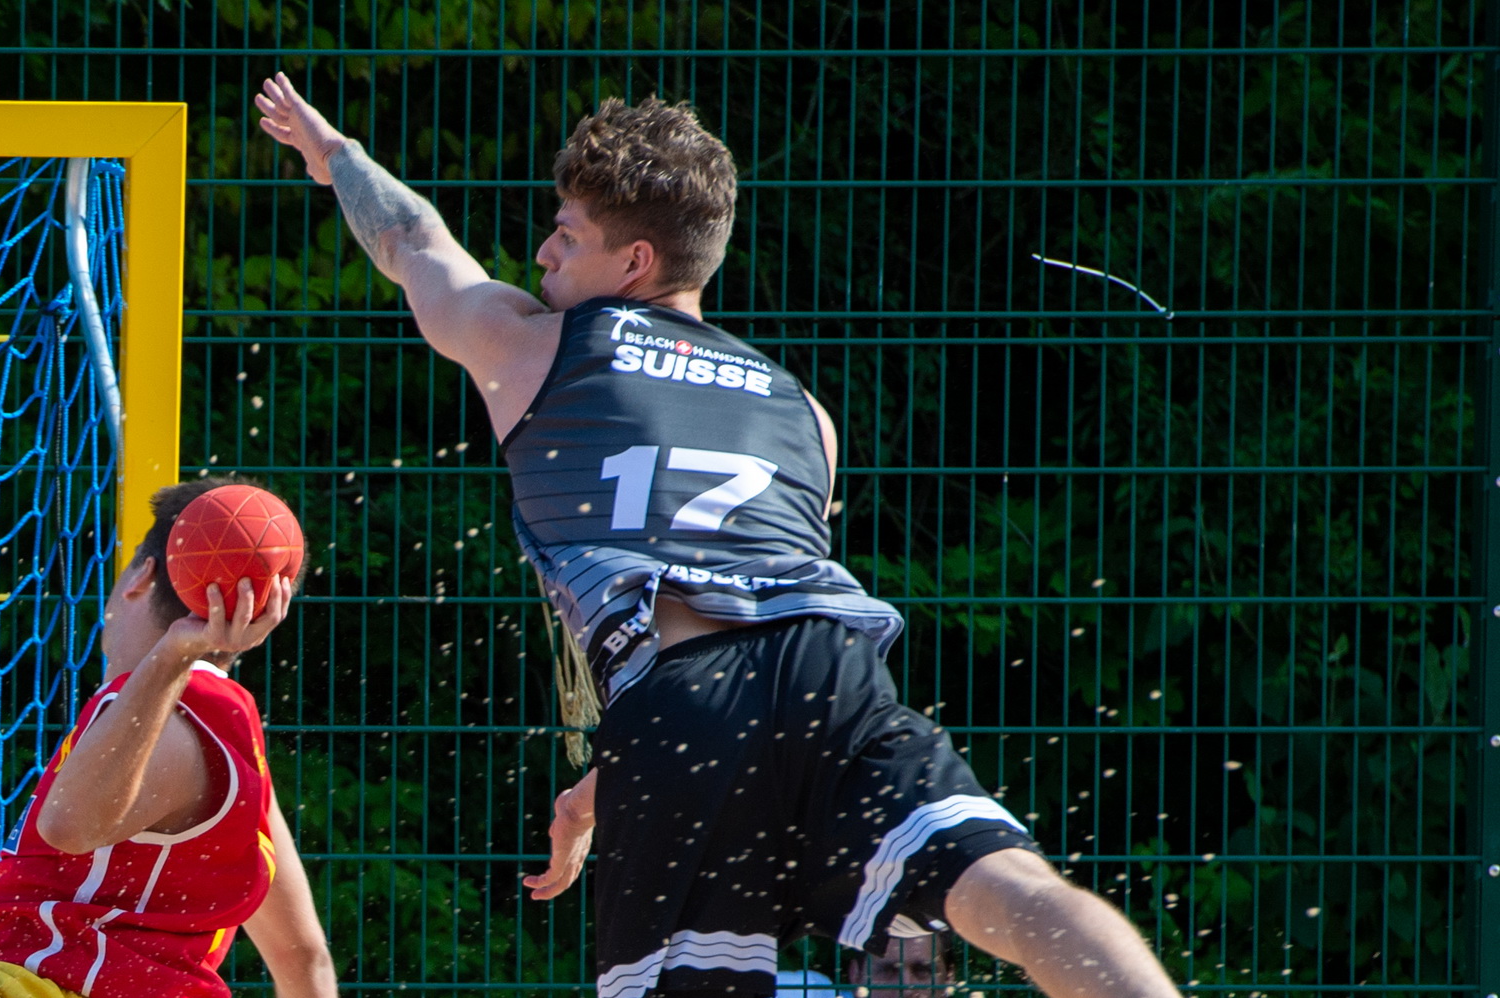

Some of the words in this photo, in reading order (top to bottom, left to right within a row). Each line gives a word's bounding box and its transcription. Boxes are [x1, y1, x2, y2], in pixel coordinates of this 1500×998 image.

[624, 331, 676, 350] BEACH
[610, 344, 773, 397] SUISSE
[600, 445, 779, 531] 17
